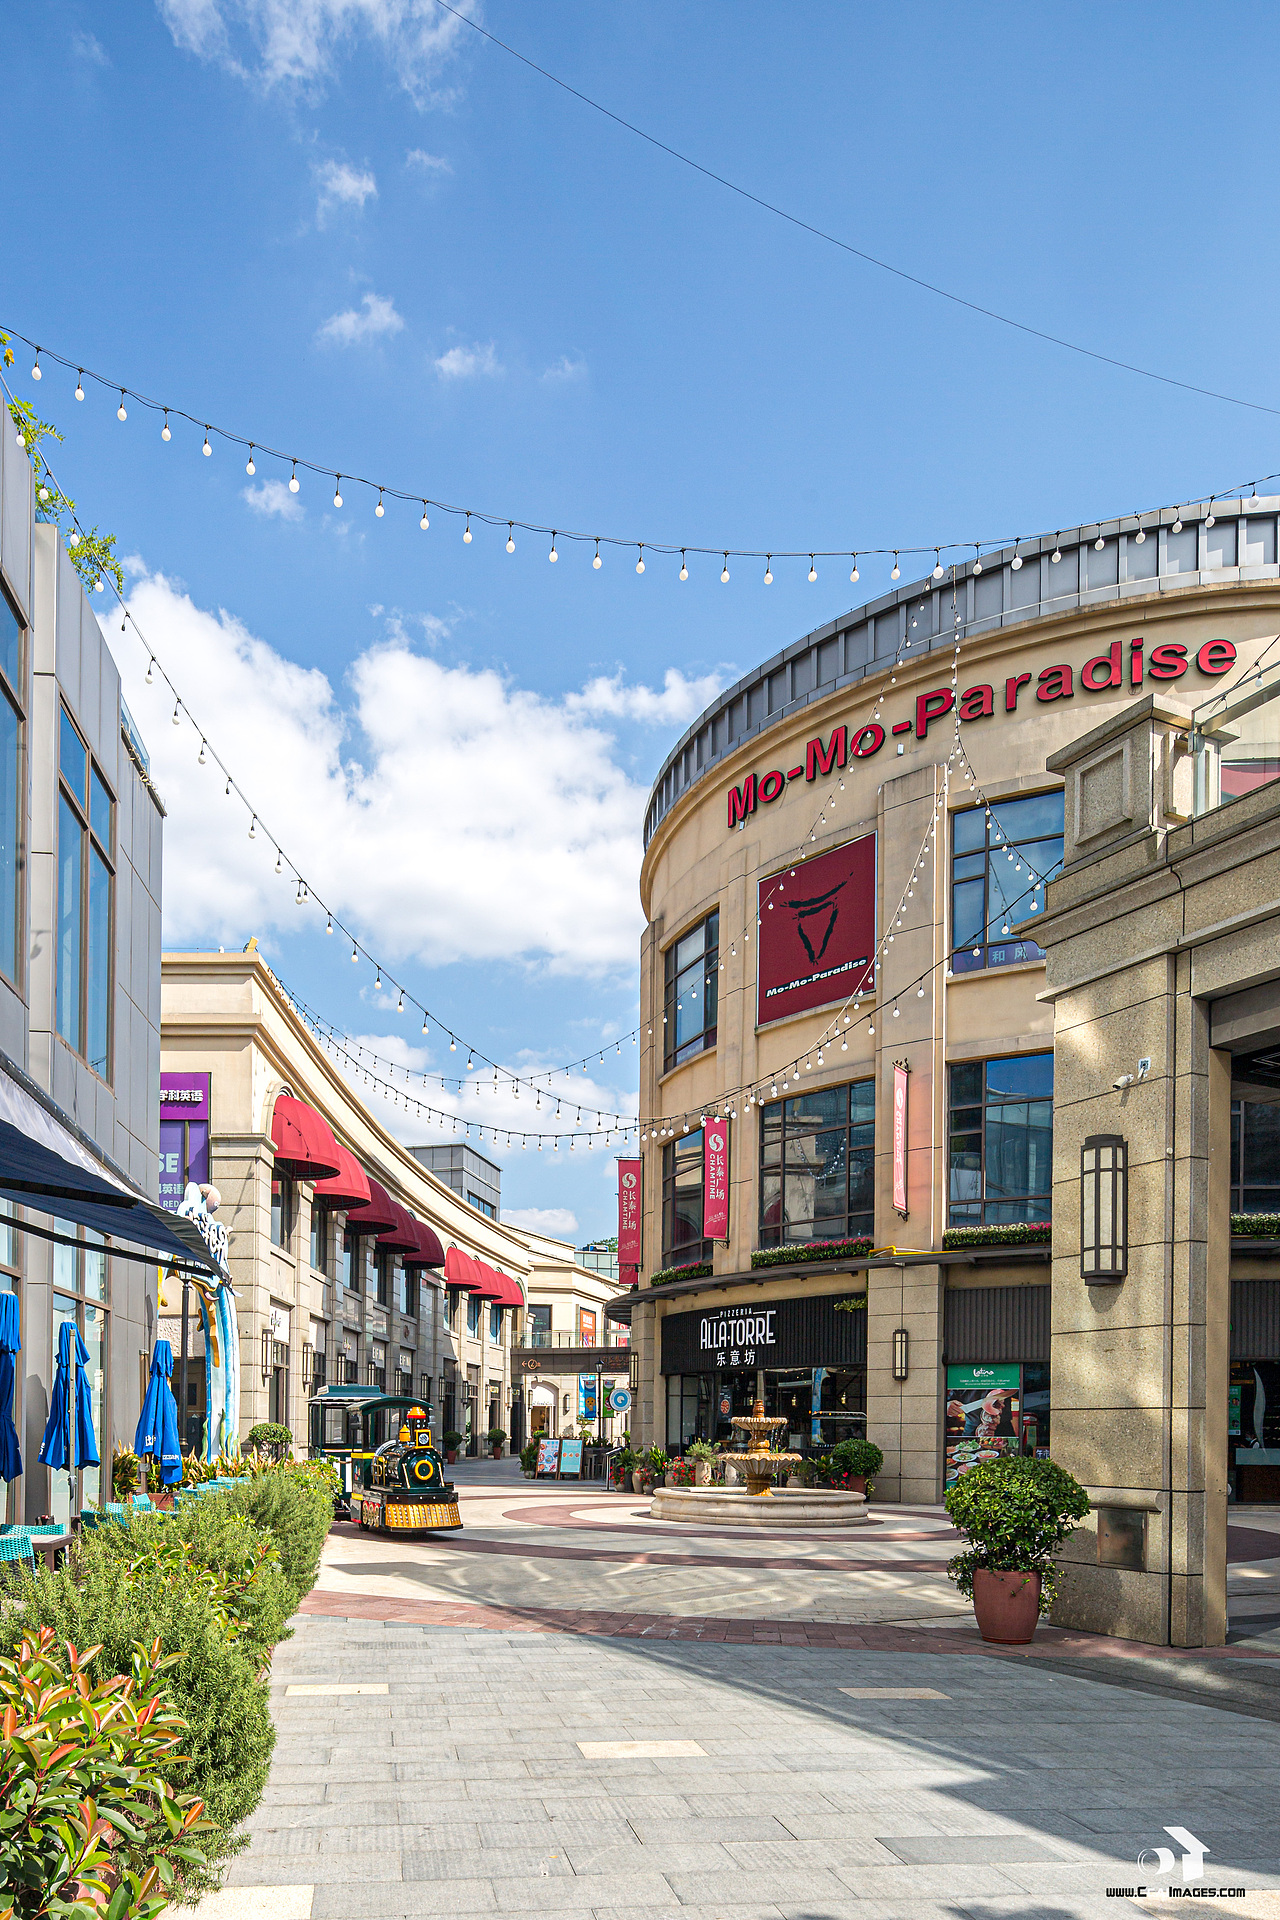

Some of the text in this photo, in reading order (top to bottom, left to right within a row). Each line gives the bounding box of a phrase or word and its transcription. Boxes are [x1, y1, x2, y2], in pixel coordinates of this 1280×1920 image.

[727, 636, 1238, 829] Mo-Mo-Paradise
[766, 958, 867, 998] Mo-Mo-Paradise
[159, 1183, 184, 1195] 英语
[719, 1307, 752, 1318] PIZZERIA
[716, 1348, 756, 1367] 乐意坊
